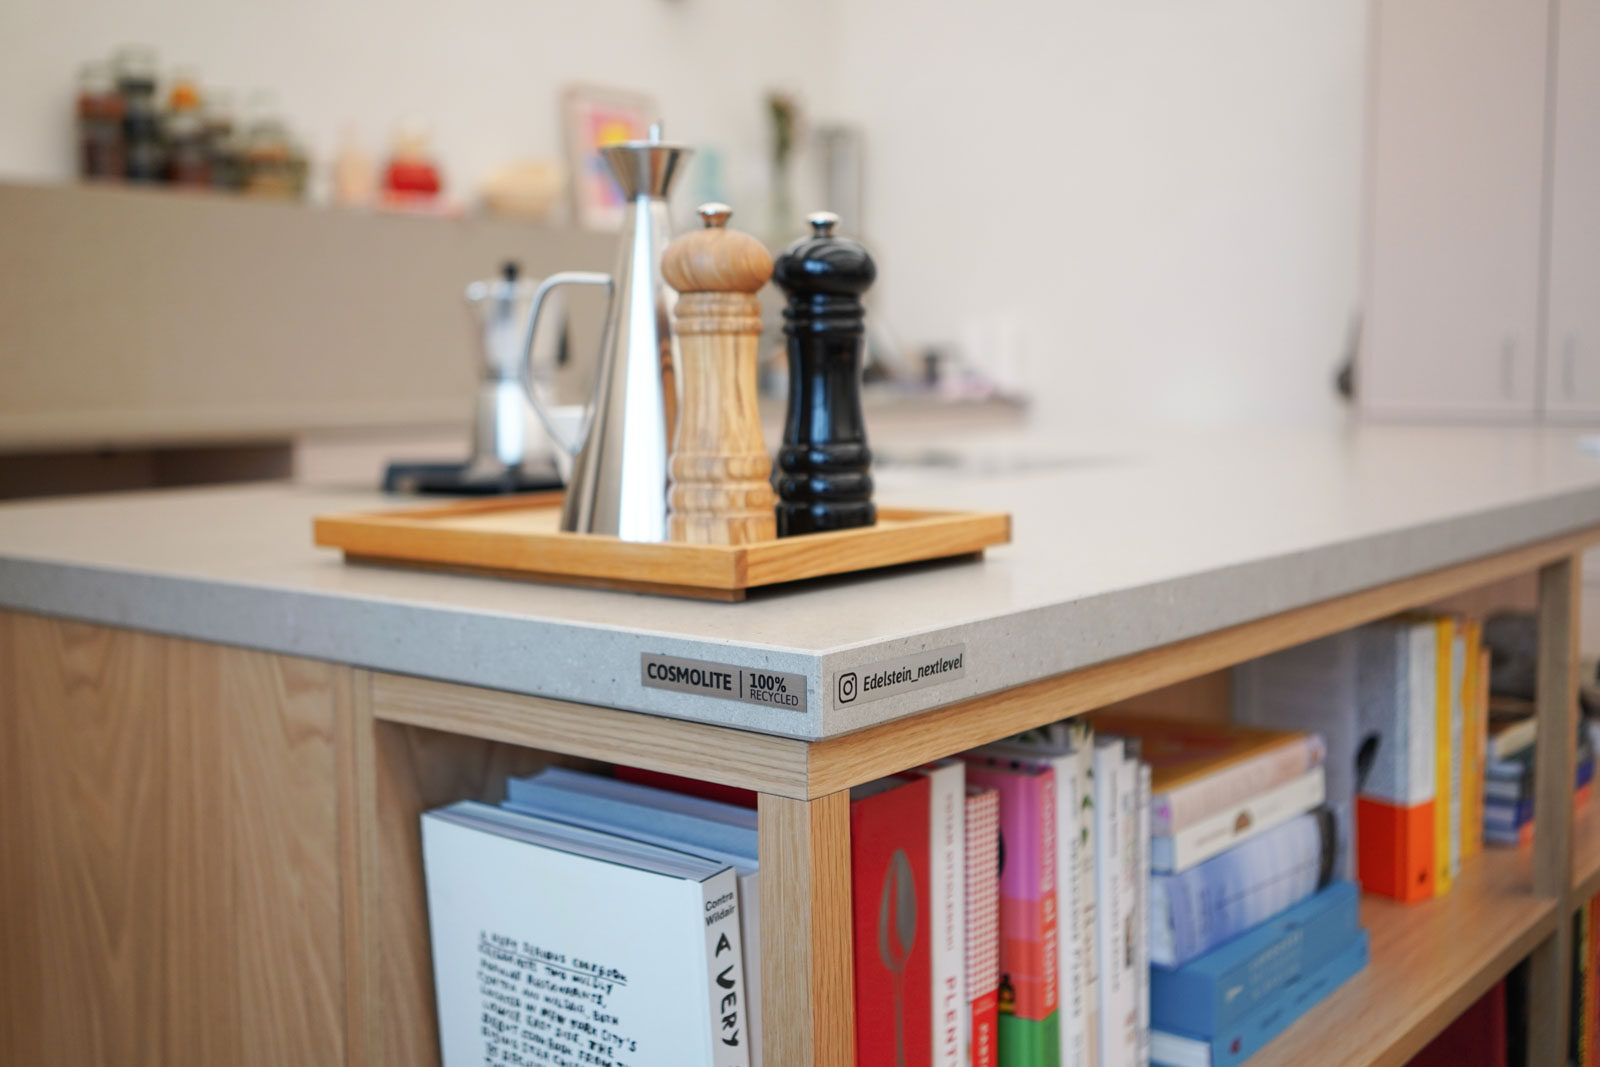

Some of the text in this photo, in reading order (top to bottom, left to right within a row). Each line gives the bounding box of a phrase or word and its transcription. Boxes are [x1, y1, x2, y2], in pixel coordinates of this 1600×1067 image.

[647, 663, 787, 693] COSMOLITE 100%
[863, 653, 963, 692] Edelstein_nextlevel
[750, 689, 799, 706] RECYCLED
[705, 891, 734, 912] Contra
[705, 905, 735, 926] Wildair
[715, 932, 732, 958] A
[716, 964, 739, 1047] VERY
